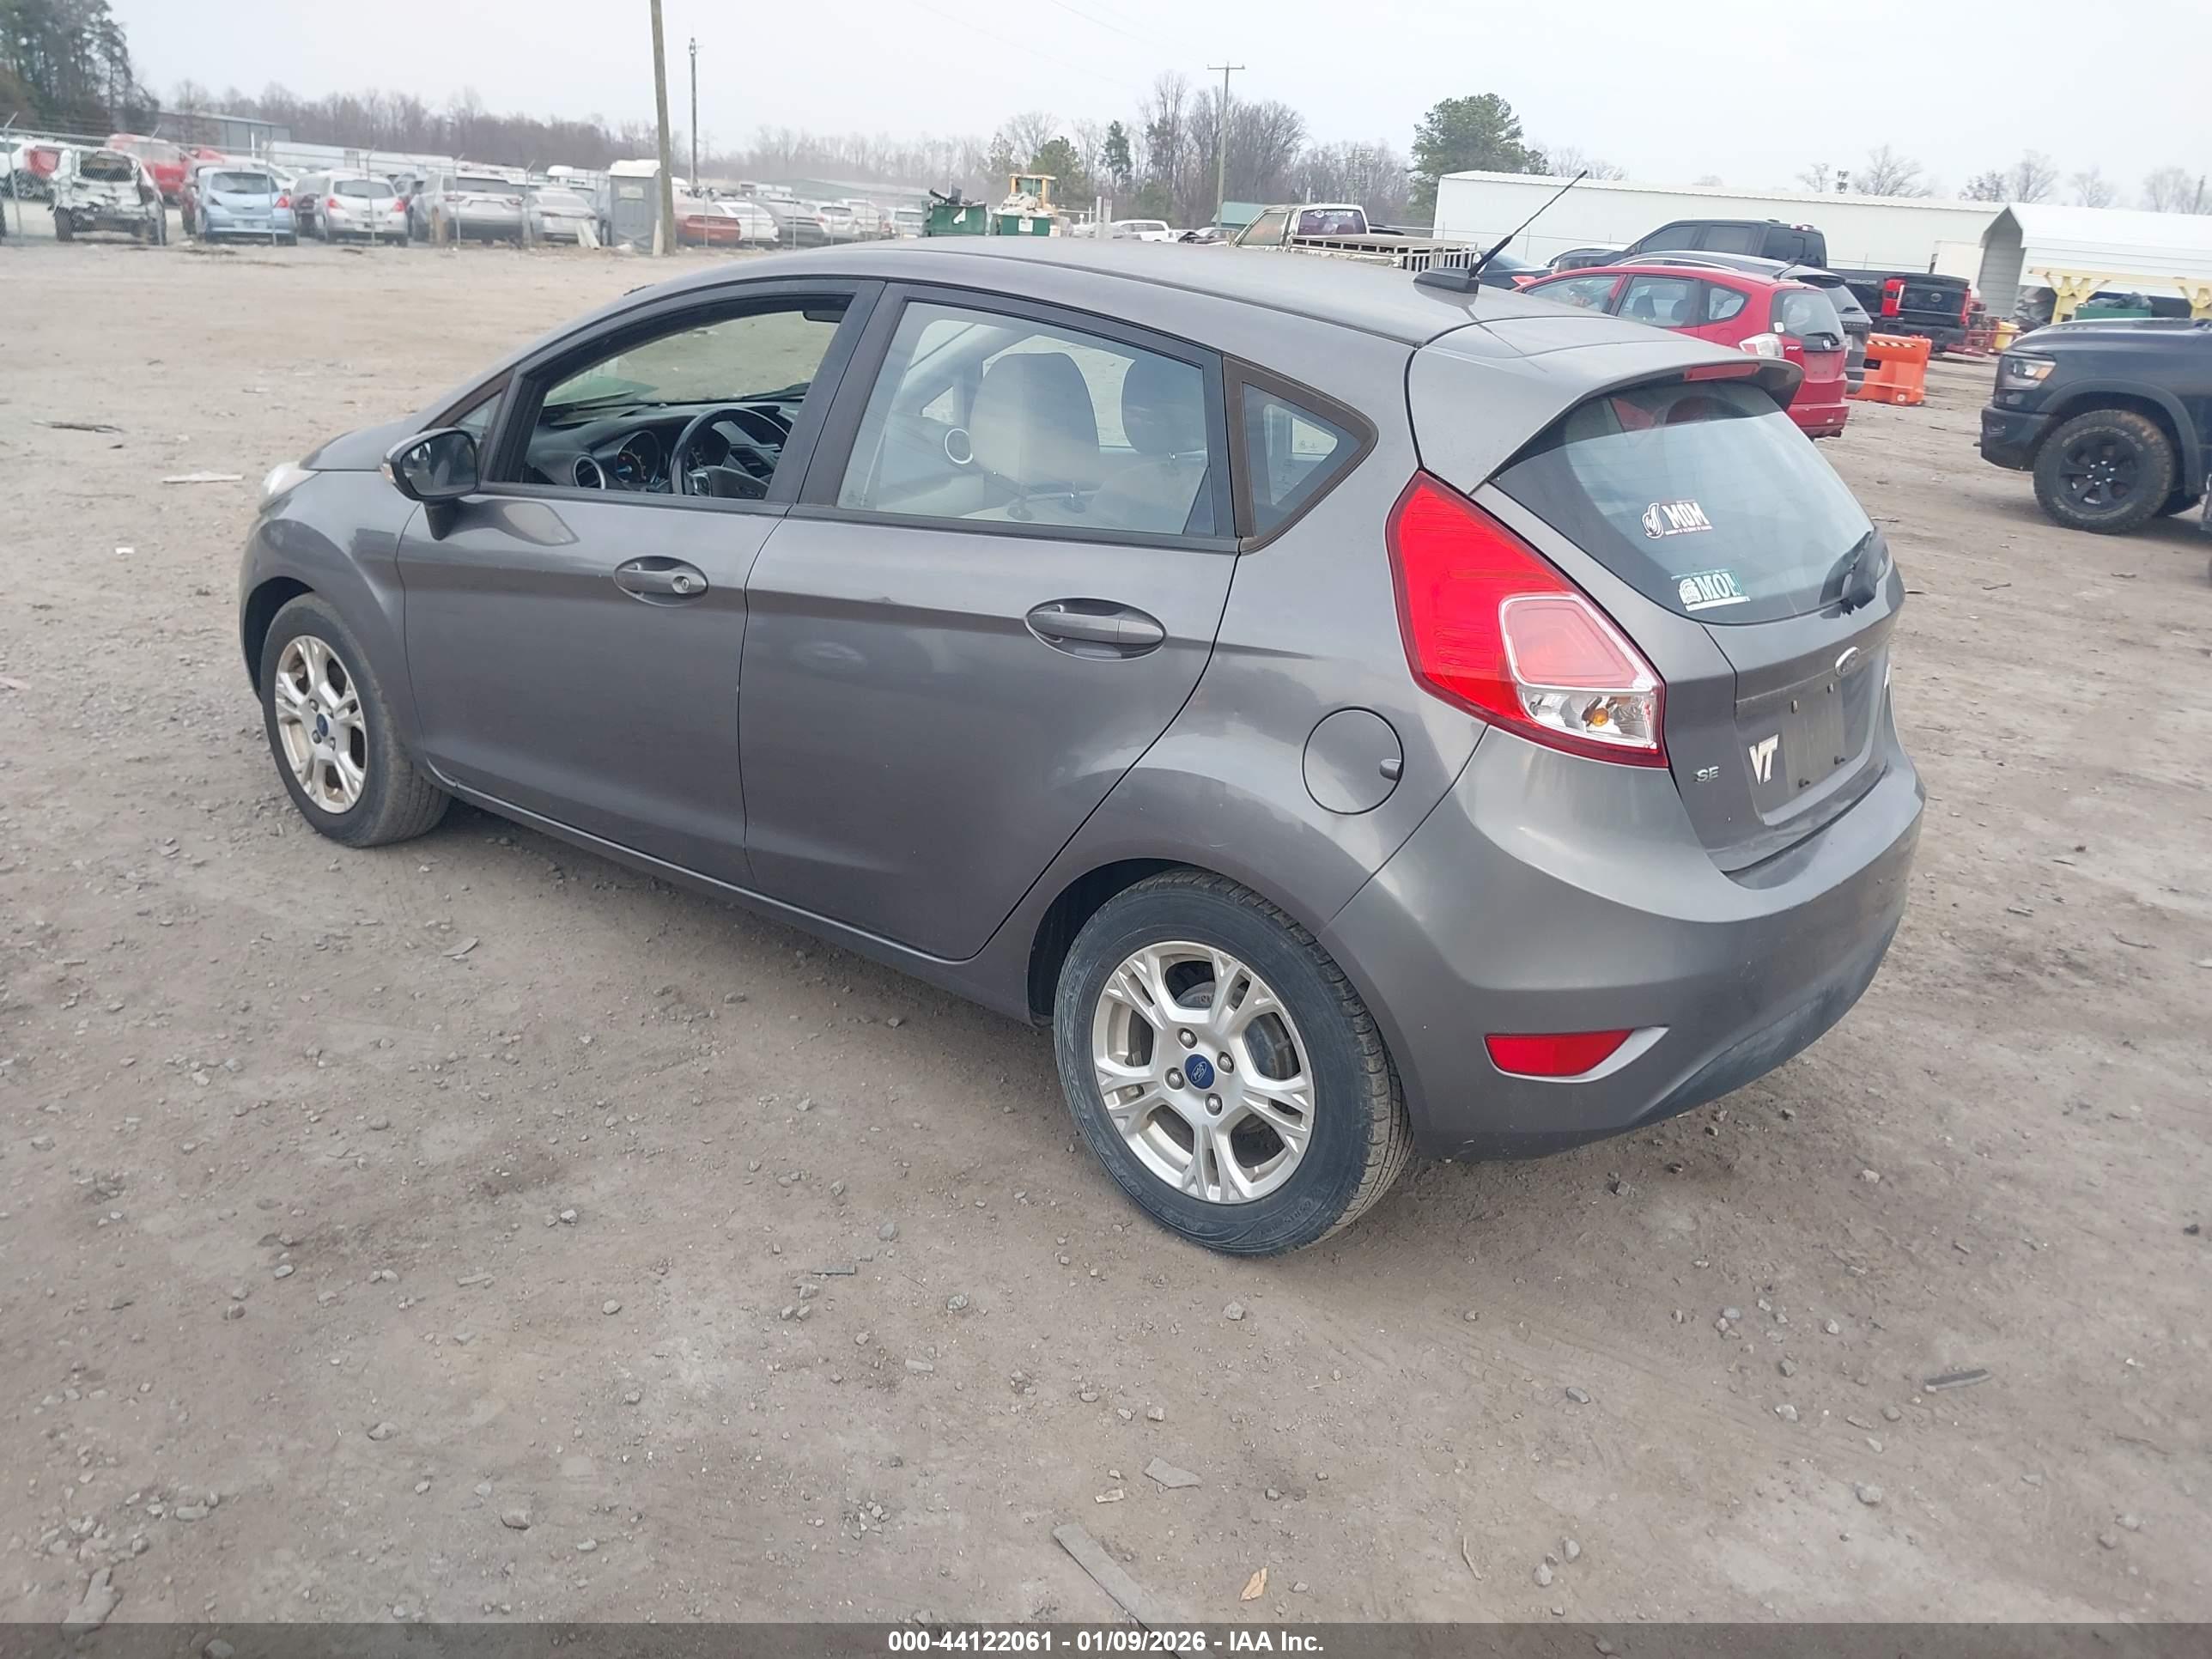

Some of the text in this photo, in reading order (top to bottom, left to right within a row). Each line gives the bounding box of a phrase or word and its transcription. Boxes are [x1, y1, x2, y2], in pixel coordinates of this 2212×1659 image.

[1661, 501, 1711, 530] MOM
[1696, 765, 1720, 783] SE
[1748, 733, 1779, 786] VT
